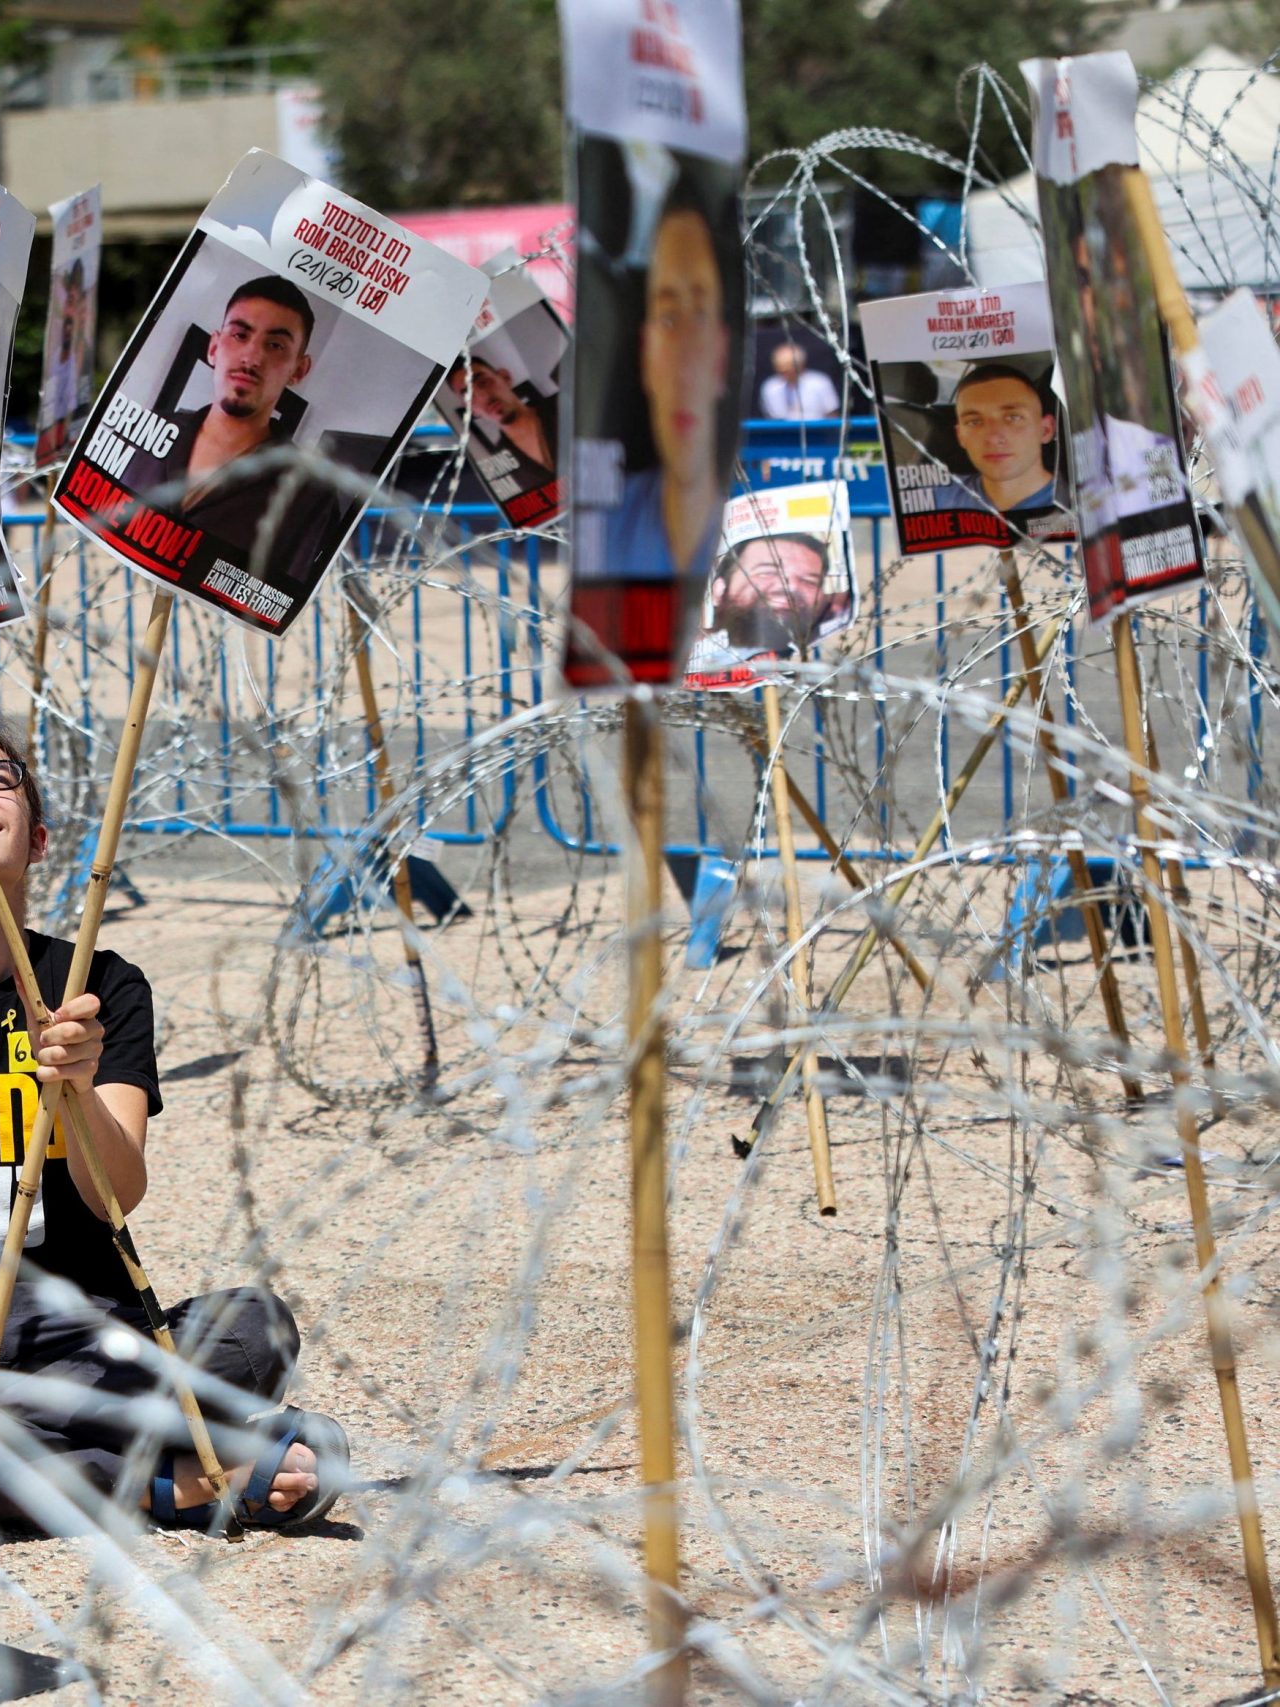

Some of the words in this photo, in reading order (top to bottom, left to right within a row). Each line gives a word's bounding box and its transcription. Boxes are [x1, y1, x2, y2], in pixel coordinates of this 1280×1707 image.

[322, 201, 387, 253] ברסלבסקי
[382, 238, 411, 267] רום
[293, 218, 331, 251] ROM
[325, 236, 411, 296] BRASLAVSKI
[927, 318, 964, 333] MATAN
[967, 311, 1015, 331] ANGREST
[102, 390, 180, 459] BRING
[84, 425, 136, 480] HIM
[896, 464, 951, 489] BRING
[67, 460, 135, 529] HOME
[124, 504, 204, 568] NOW!
[899, 487, 936, 515] HIM
[903, 511, 955, 542] HOME
[957, 511, 1009, 538] NOW!
[203, 569, 251, 605] FAMILIES
[247, 591, 287, 623] FORUM
[212, 558, 249, 585] HOSTAGES
[245, 576, 264, 593] AND
[260, 583, 295, 609] MISSING
